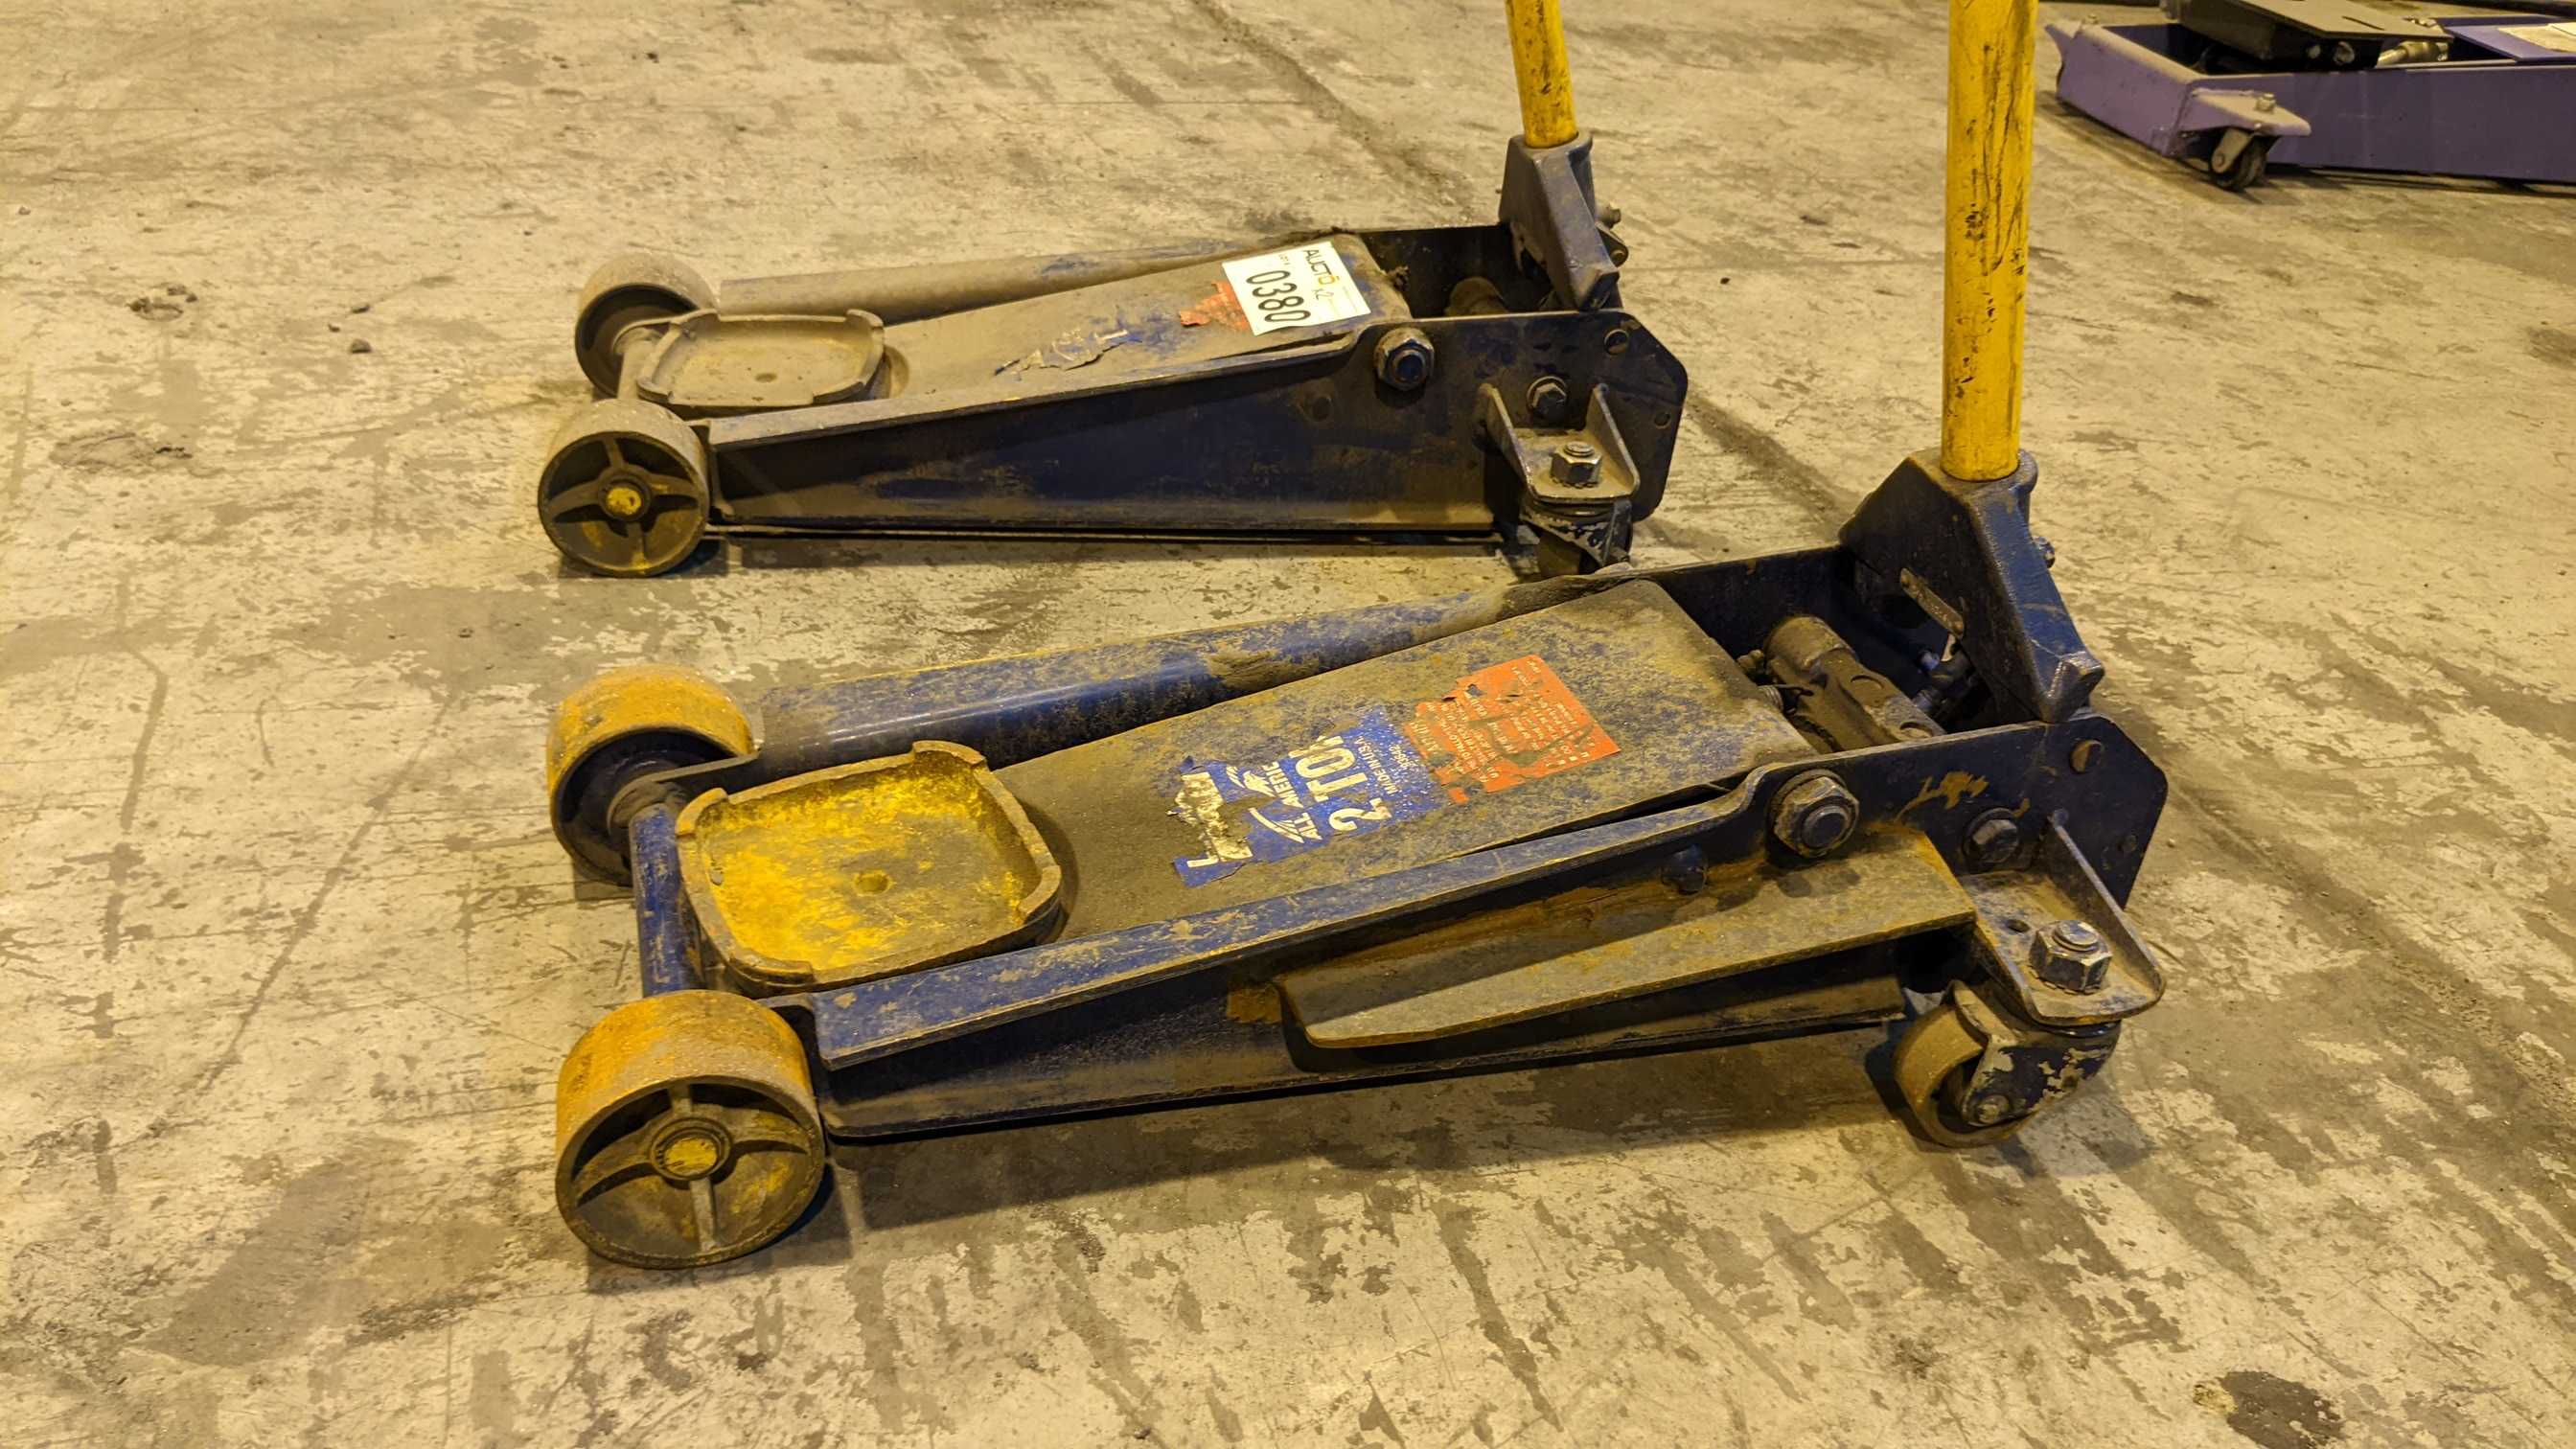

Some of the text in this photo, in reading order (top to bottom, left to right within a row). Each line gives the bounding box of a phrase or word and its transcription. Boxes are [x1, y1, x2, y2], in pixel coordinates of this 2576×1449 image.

[1246, 269, 1311, 323] 0380
[1367, 759, 1382, 770] IN
[1372, 768, 1399, 794] MADE
[1262, 761, 1322, 840] ALL AMERIC
[1328, 797, 1392, 831] 2
